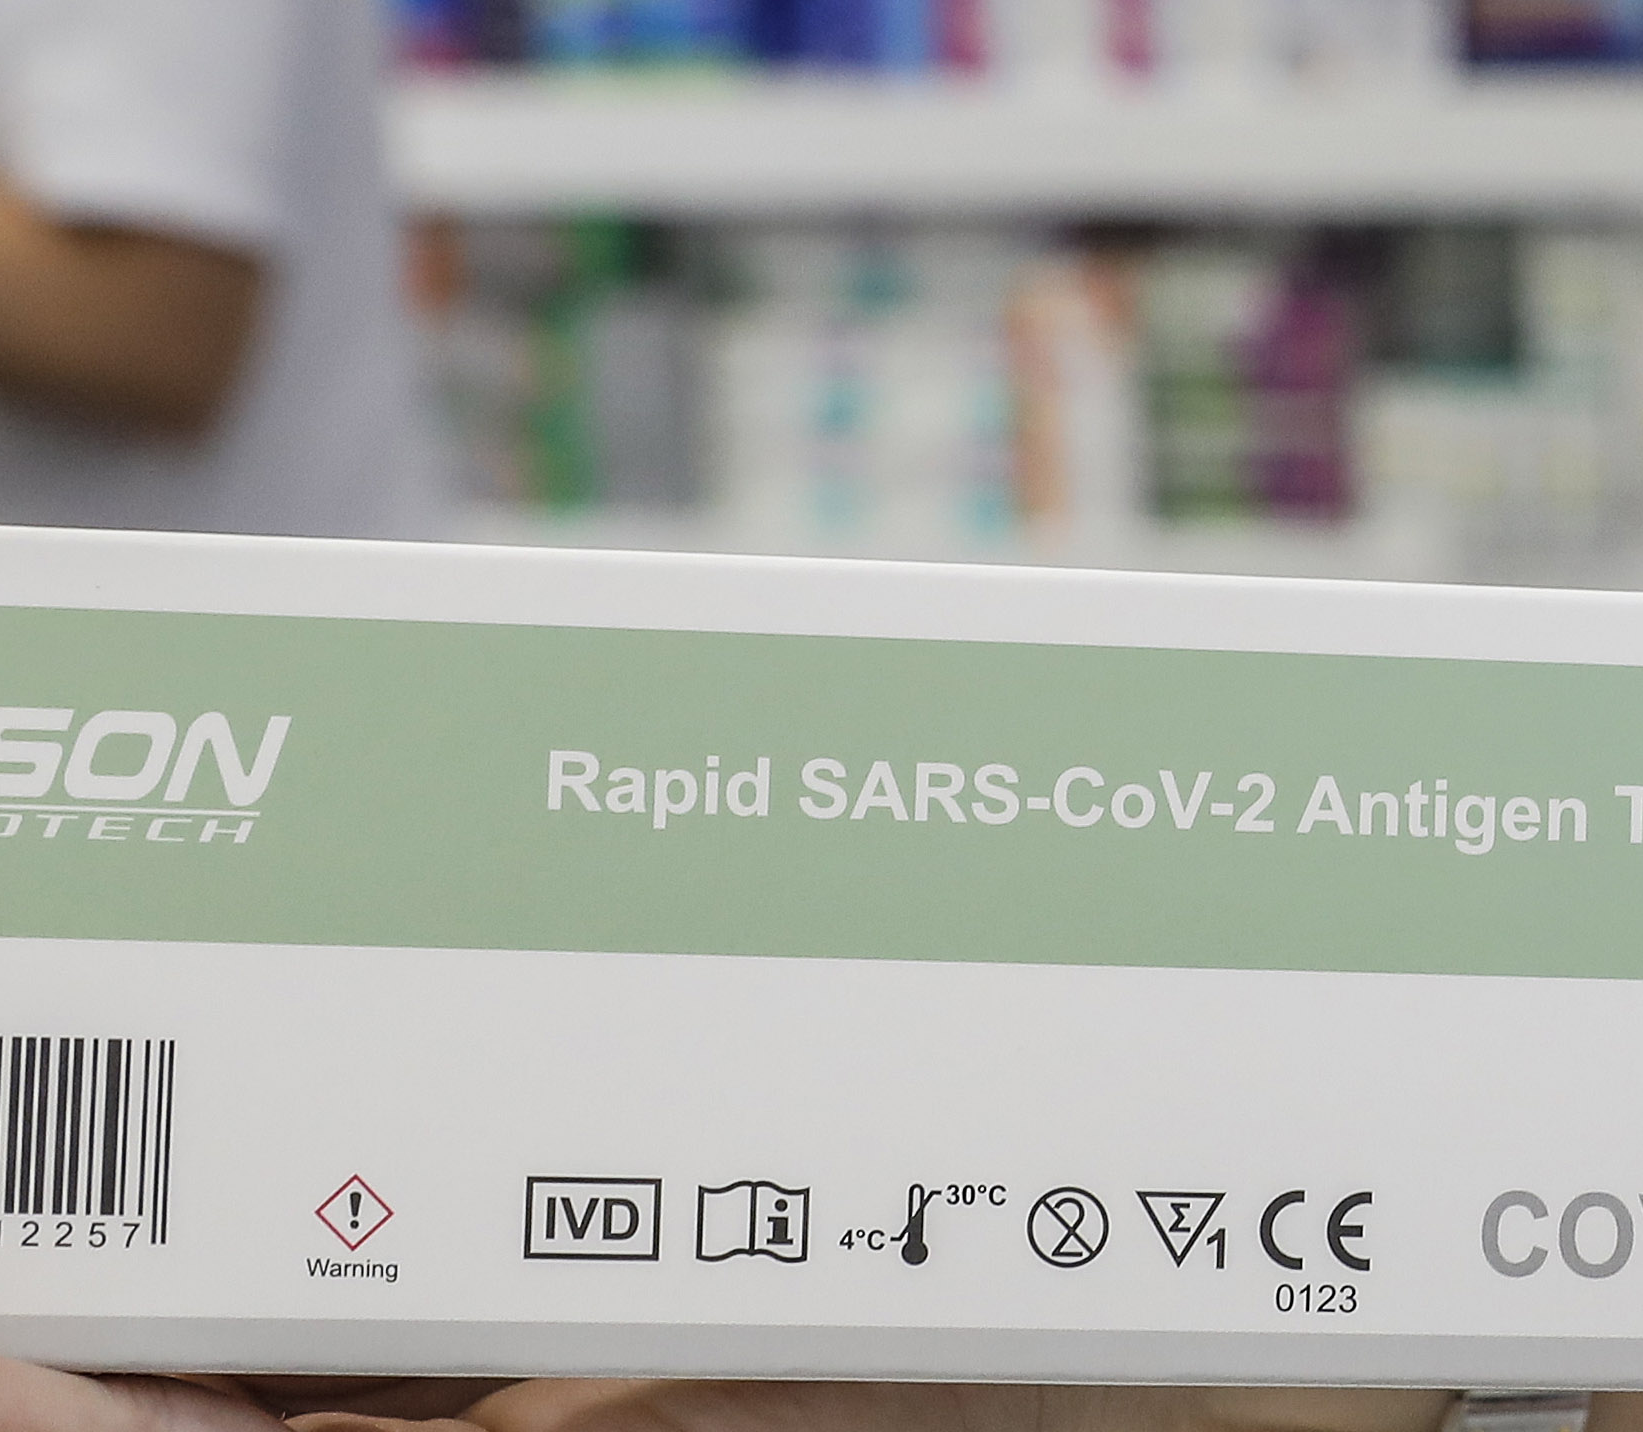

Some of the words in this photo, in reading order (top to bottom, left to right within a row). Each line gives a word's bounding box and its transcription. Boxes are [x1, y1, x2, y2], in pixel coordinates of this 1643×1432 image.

[546, 749, 771, 830] Rapid
[797, 756, 1277, 833] SARS-CoV-2
[1296, 773, 1588, 856] Antigen
[944, 1183, 1008, 1208] 30°C
[544, 1196, 641, 1242] IVD
[839, 1229, 887, 1252] 4°C
[306, 1257, 400, 1284] Warning
[1274, 1282, 1359, 1315] 0123
